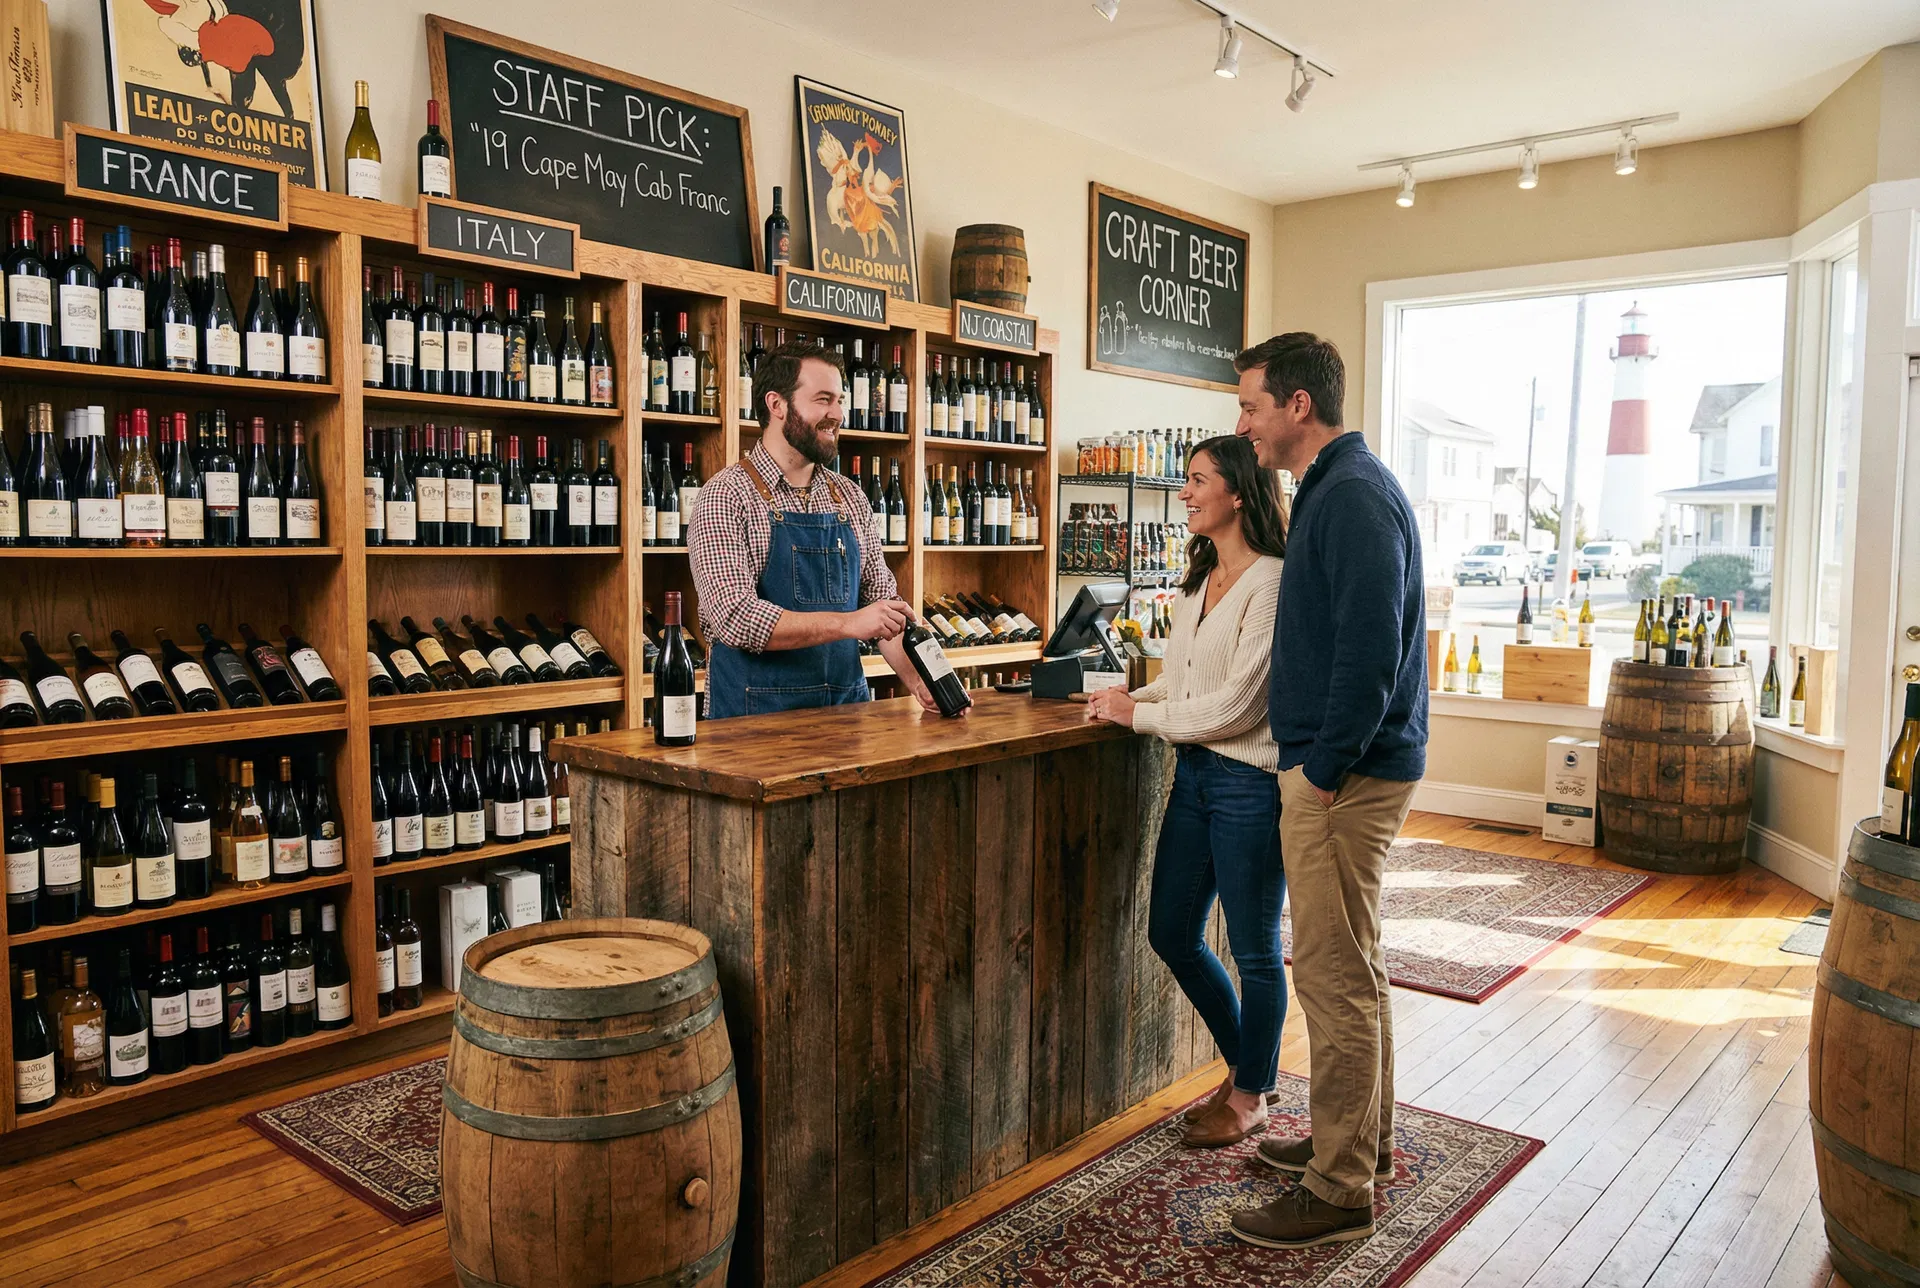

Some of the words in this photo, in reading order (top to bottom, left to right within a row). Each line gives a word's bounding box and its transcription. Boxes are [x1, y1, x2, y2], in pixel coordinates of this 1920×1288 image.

[133, 91, 193, 126] LEAU
[210, 108, 307, 150] CONNER
[493, 59, 604, 127] STAFF
[625, 95, 710, 157] PICK:
[102, 147, 254, 211] FRANCE
[521, 136, 579, 190] Cape
[584, 152, 627, 208] May
[635, 162, 672, 201] Cab
[678, 172, 730, 215] Franc
[457, 216, 545, 260] ITALY
[821, 247, 911, 285] CALIFORNIA
[1105, 211, 1181, 273] CRAFT
[1189, 234, 1238, 292] BEER
[788, 278, 883, 319] CALIFORNIA
[1139, 274, 1211, 329] CORNER
[961, 311, 981, 336] NJ
[982, 316, 1033, 346] COASTAL
